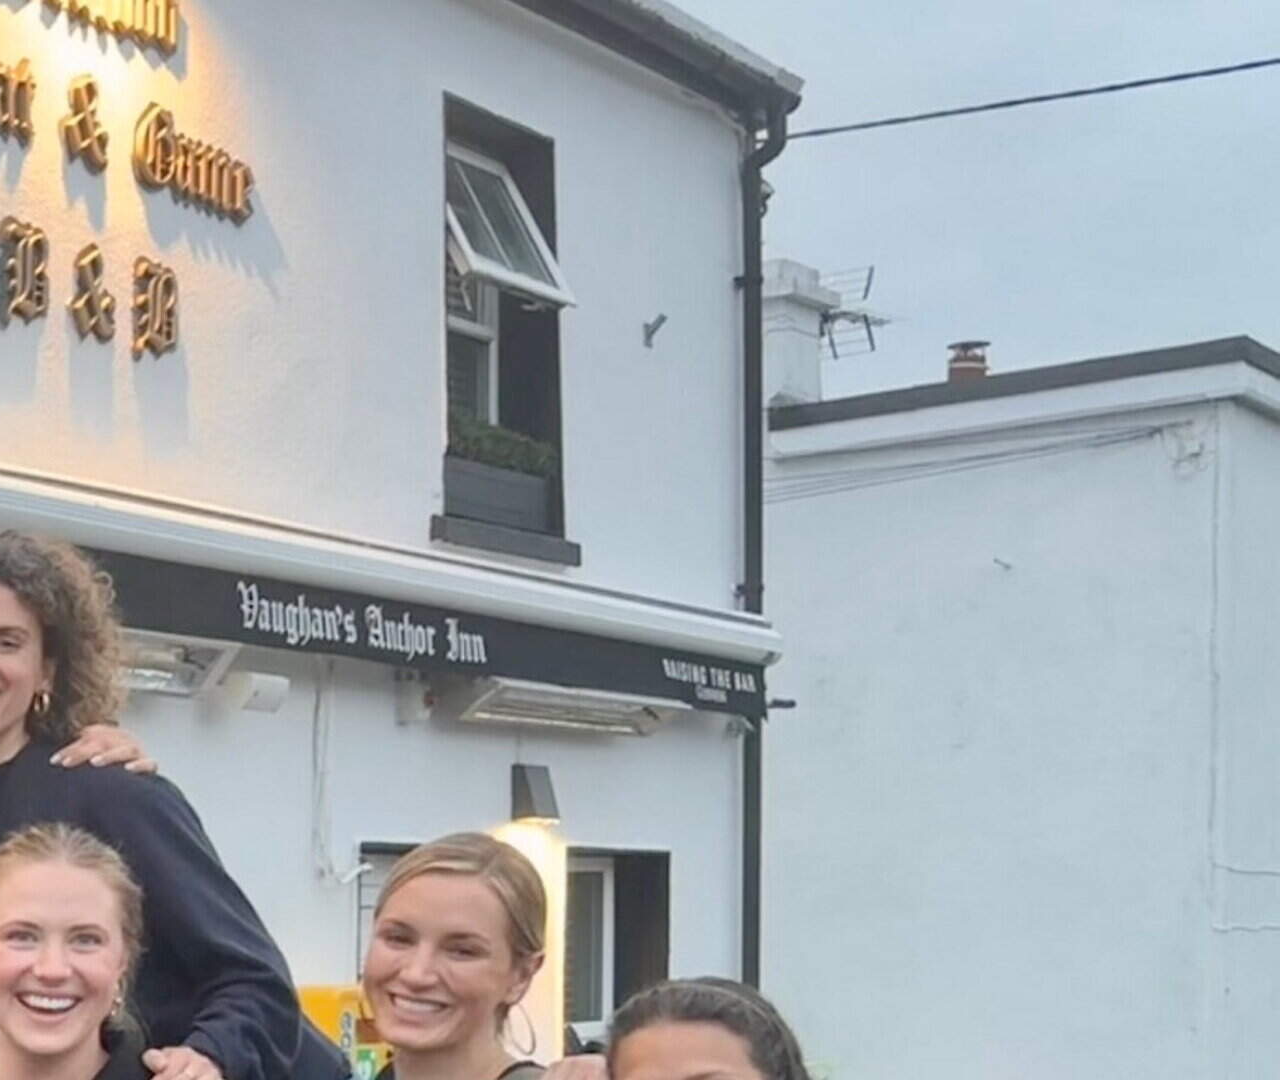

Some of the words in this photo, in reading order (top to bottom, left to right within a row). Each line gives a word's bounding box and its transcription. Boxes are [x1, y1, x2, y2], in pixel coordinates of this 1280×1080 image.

[59, 74, 110, 175] &
[132, 102, 255, 226] Game
[67, 243, 115, 343] &
[132, 256, 180, 362] B
[237, 581, 358, 646] Vaughan's
[364, 604, 436, 661] Anchor
[445, 617, 487, 663] Inn
